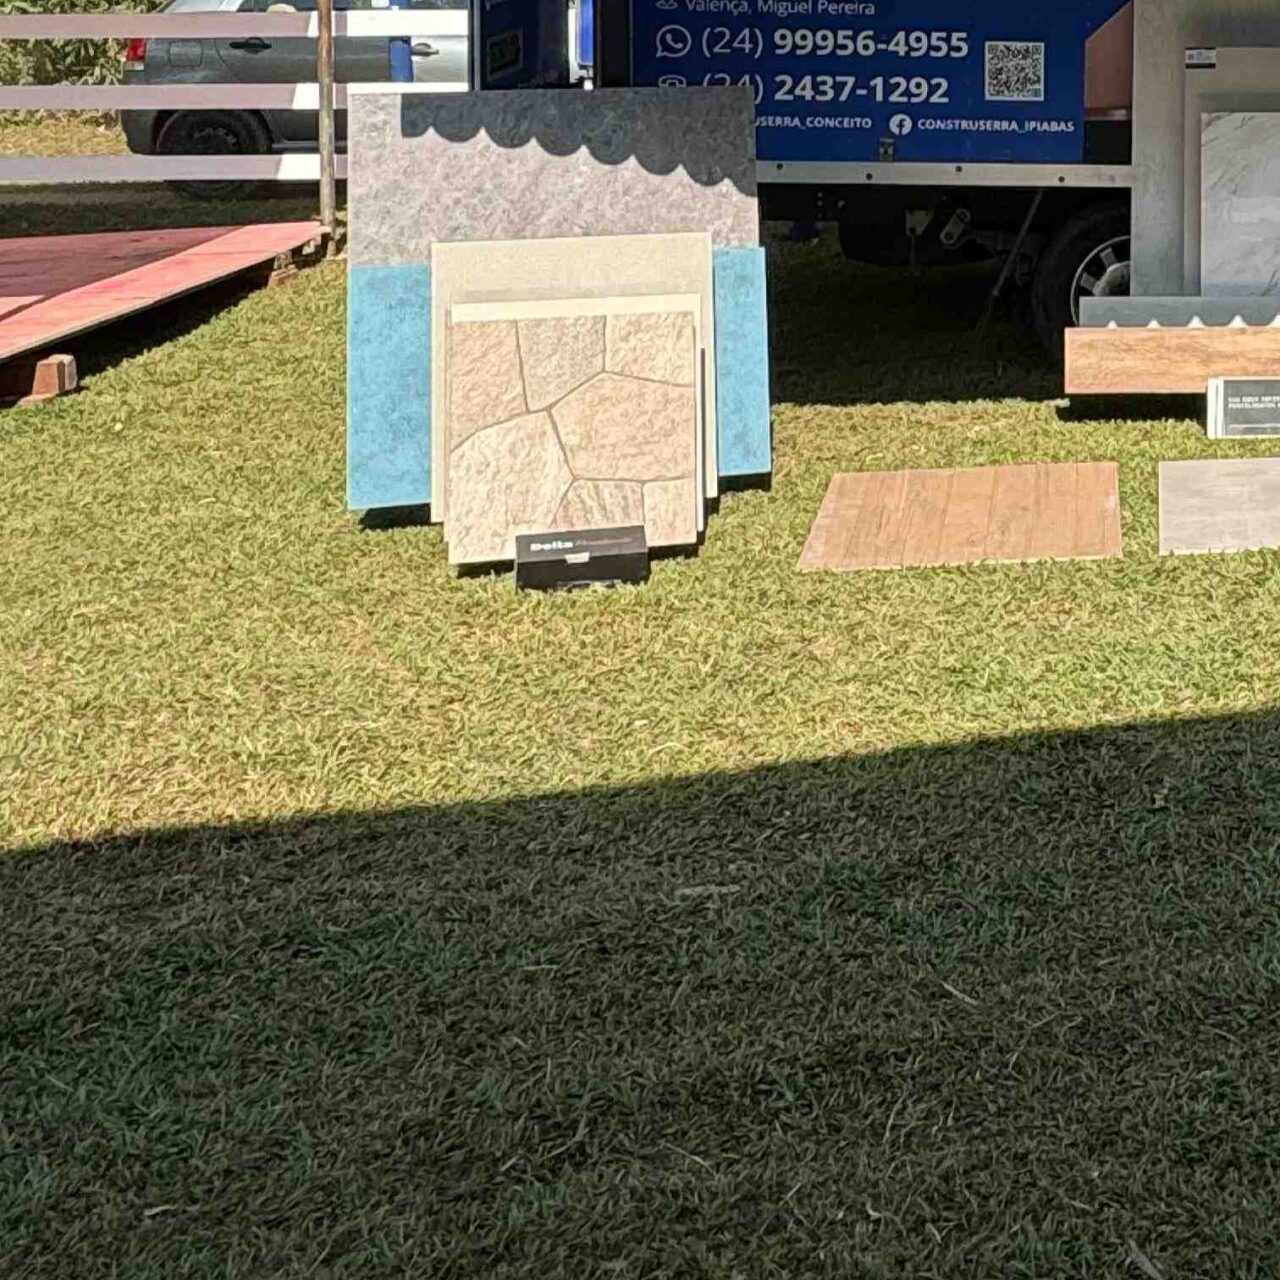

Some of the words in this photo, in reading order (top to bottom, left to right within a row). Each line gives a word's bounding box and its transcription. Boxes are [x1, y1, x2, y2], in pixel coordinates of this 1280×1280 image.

[817, 0, 875, 16] Pereira
[701, 27, 764, 58] (24)
[773, 28, 969, 58] 99956-4955
[773, 74, 950, 104] 2437-1292
[917, 118, 1076, 134] CONSTRUSERRA_IPIABAS
